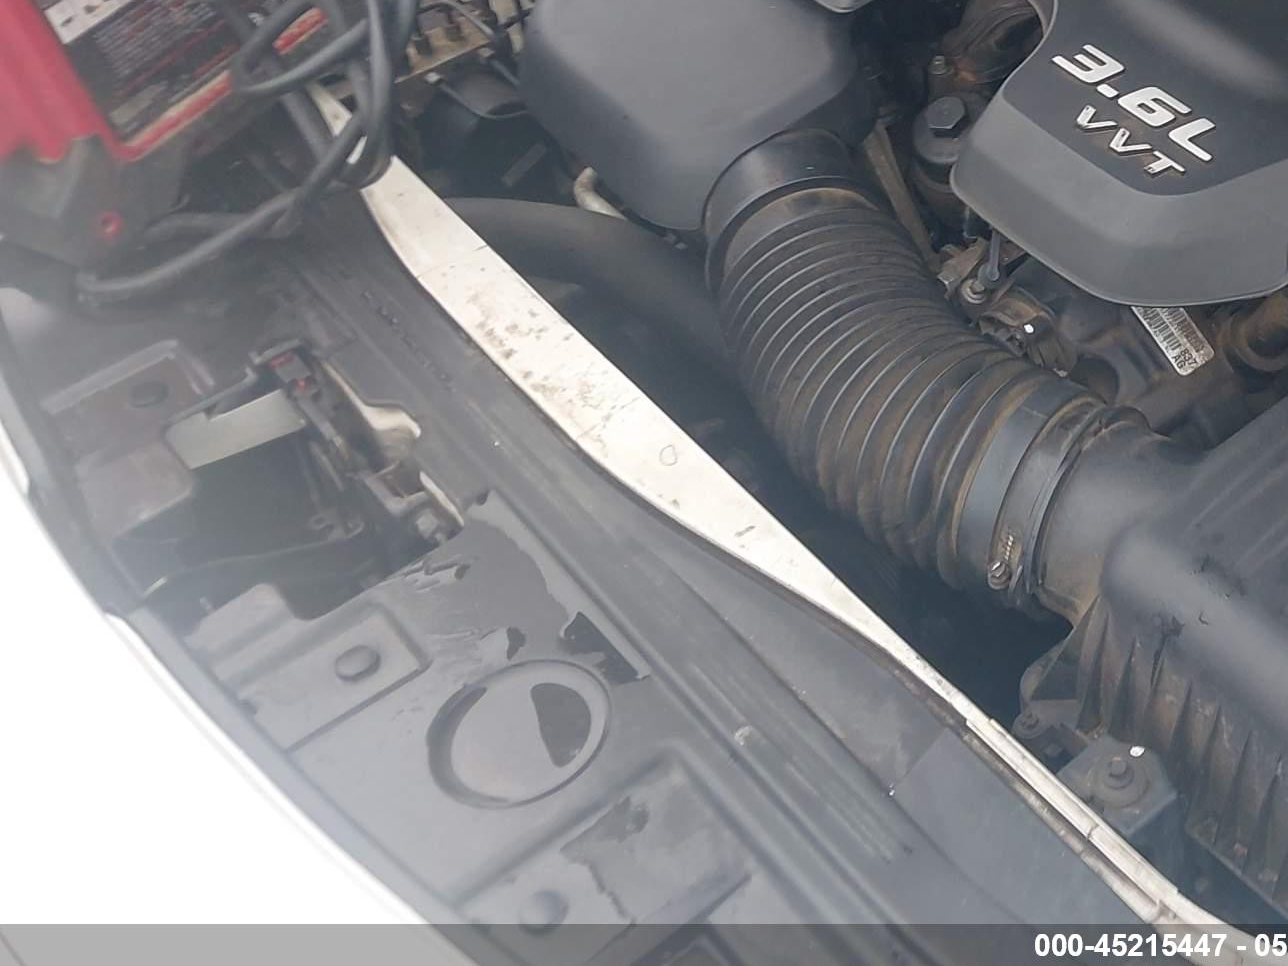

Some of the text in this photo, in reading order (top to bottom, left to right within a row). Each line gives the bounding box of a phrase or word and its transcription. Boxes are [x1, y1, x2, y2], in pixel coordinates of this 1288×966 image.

[1051, 43, 1217, 162] 3.6L
[1075, 104, 1187, 174] VVT
[1171, 353, 1186, 369] AG
[1180, 348, 1198, 366] 837
